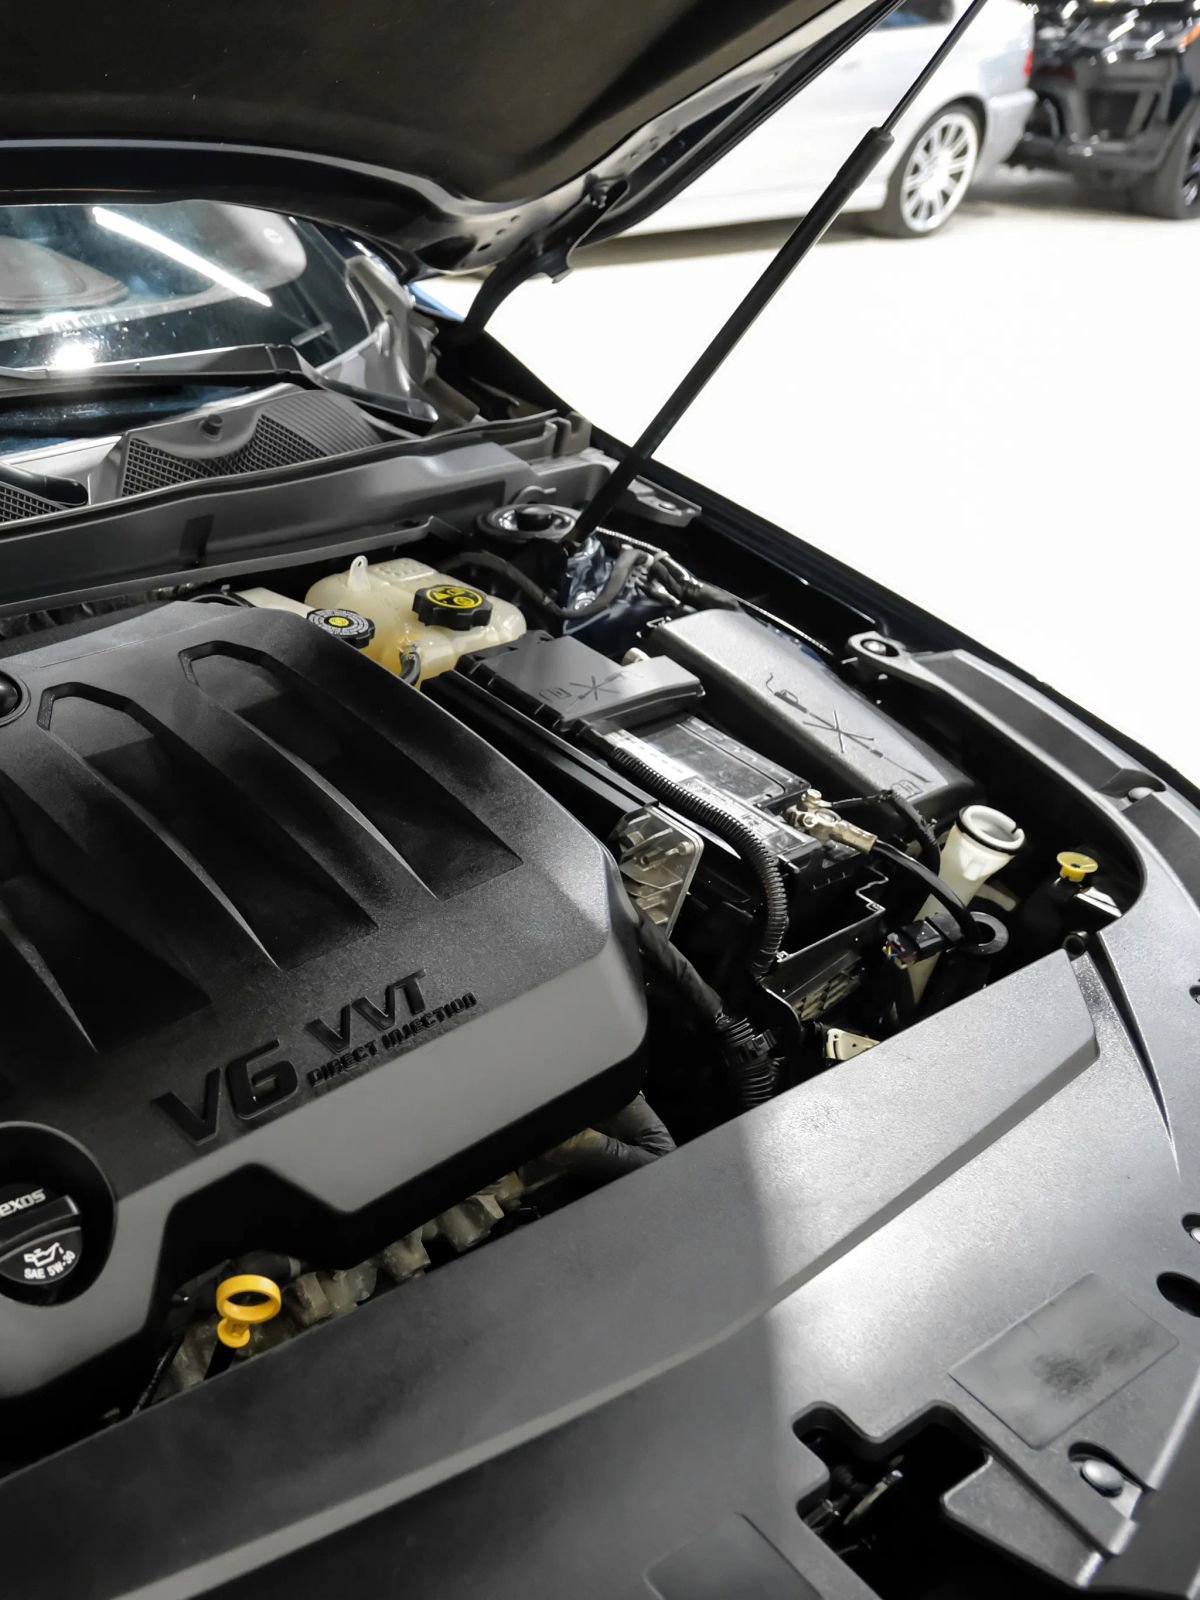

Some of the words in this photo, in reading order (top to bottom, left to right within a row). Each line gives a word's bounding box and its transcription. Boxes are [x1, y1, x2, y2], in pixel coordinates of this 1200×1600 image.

[152, 1038, 299, 1145] V6
[304, 968, 426, 1054] VVT
[306, 1039, 377, 1088] DIRECT
[382, 991, 478, 1051] INJECTION
[24, 1267, 46, 1279] SAE
[47, 1250, 76, 1276] 5W-30
